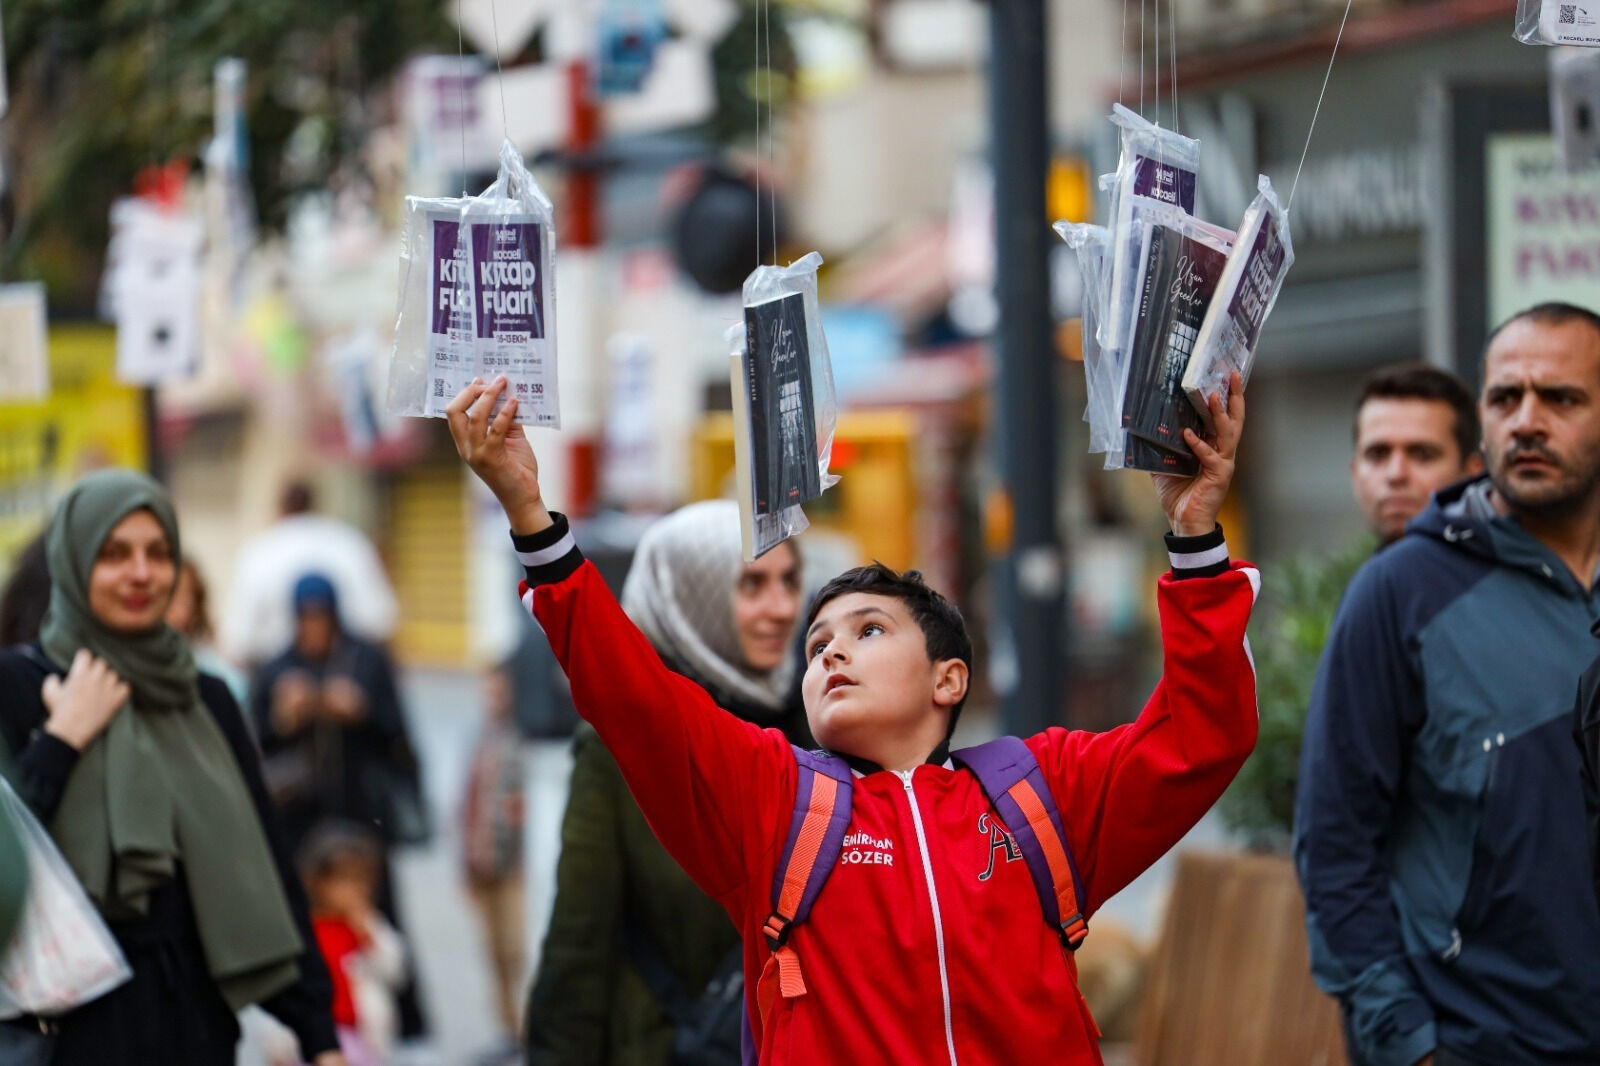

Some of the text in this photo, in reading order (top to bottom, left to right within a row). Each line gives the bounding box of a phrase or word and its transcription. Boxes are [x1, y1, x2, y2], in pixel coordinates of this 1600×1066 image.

[481, 261, 535, 290] Kitap
[1176, 256, 1203, 287] Uzun
[531, 383, 544, 394] 530
[841, 847, 894, 867] SÖZER
